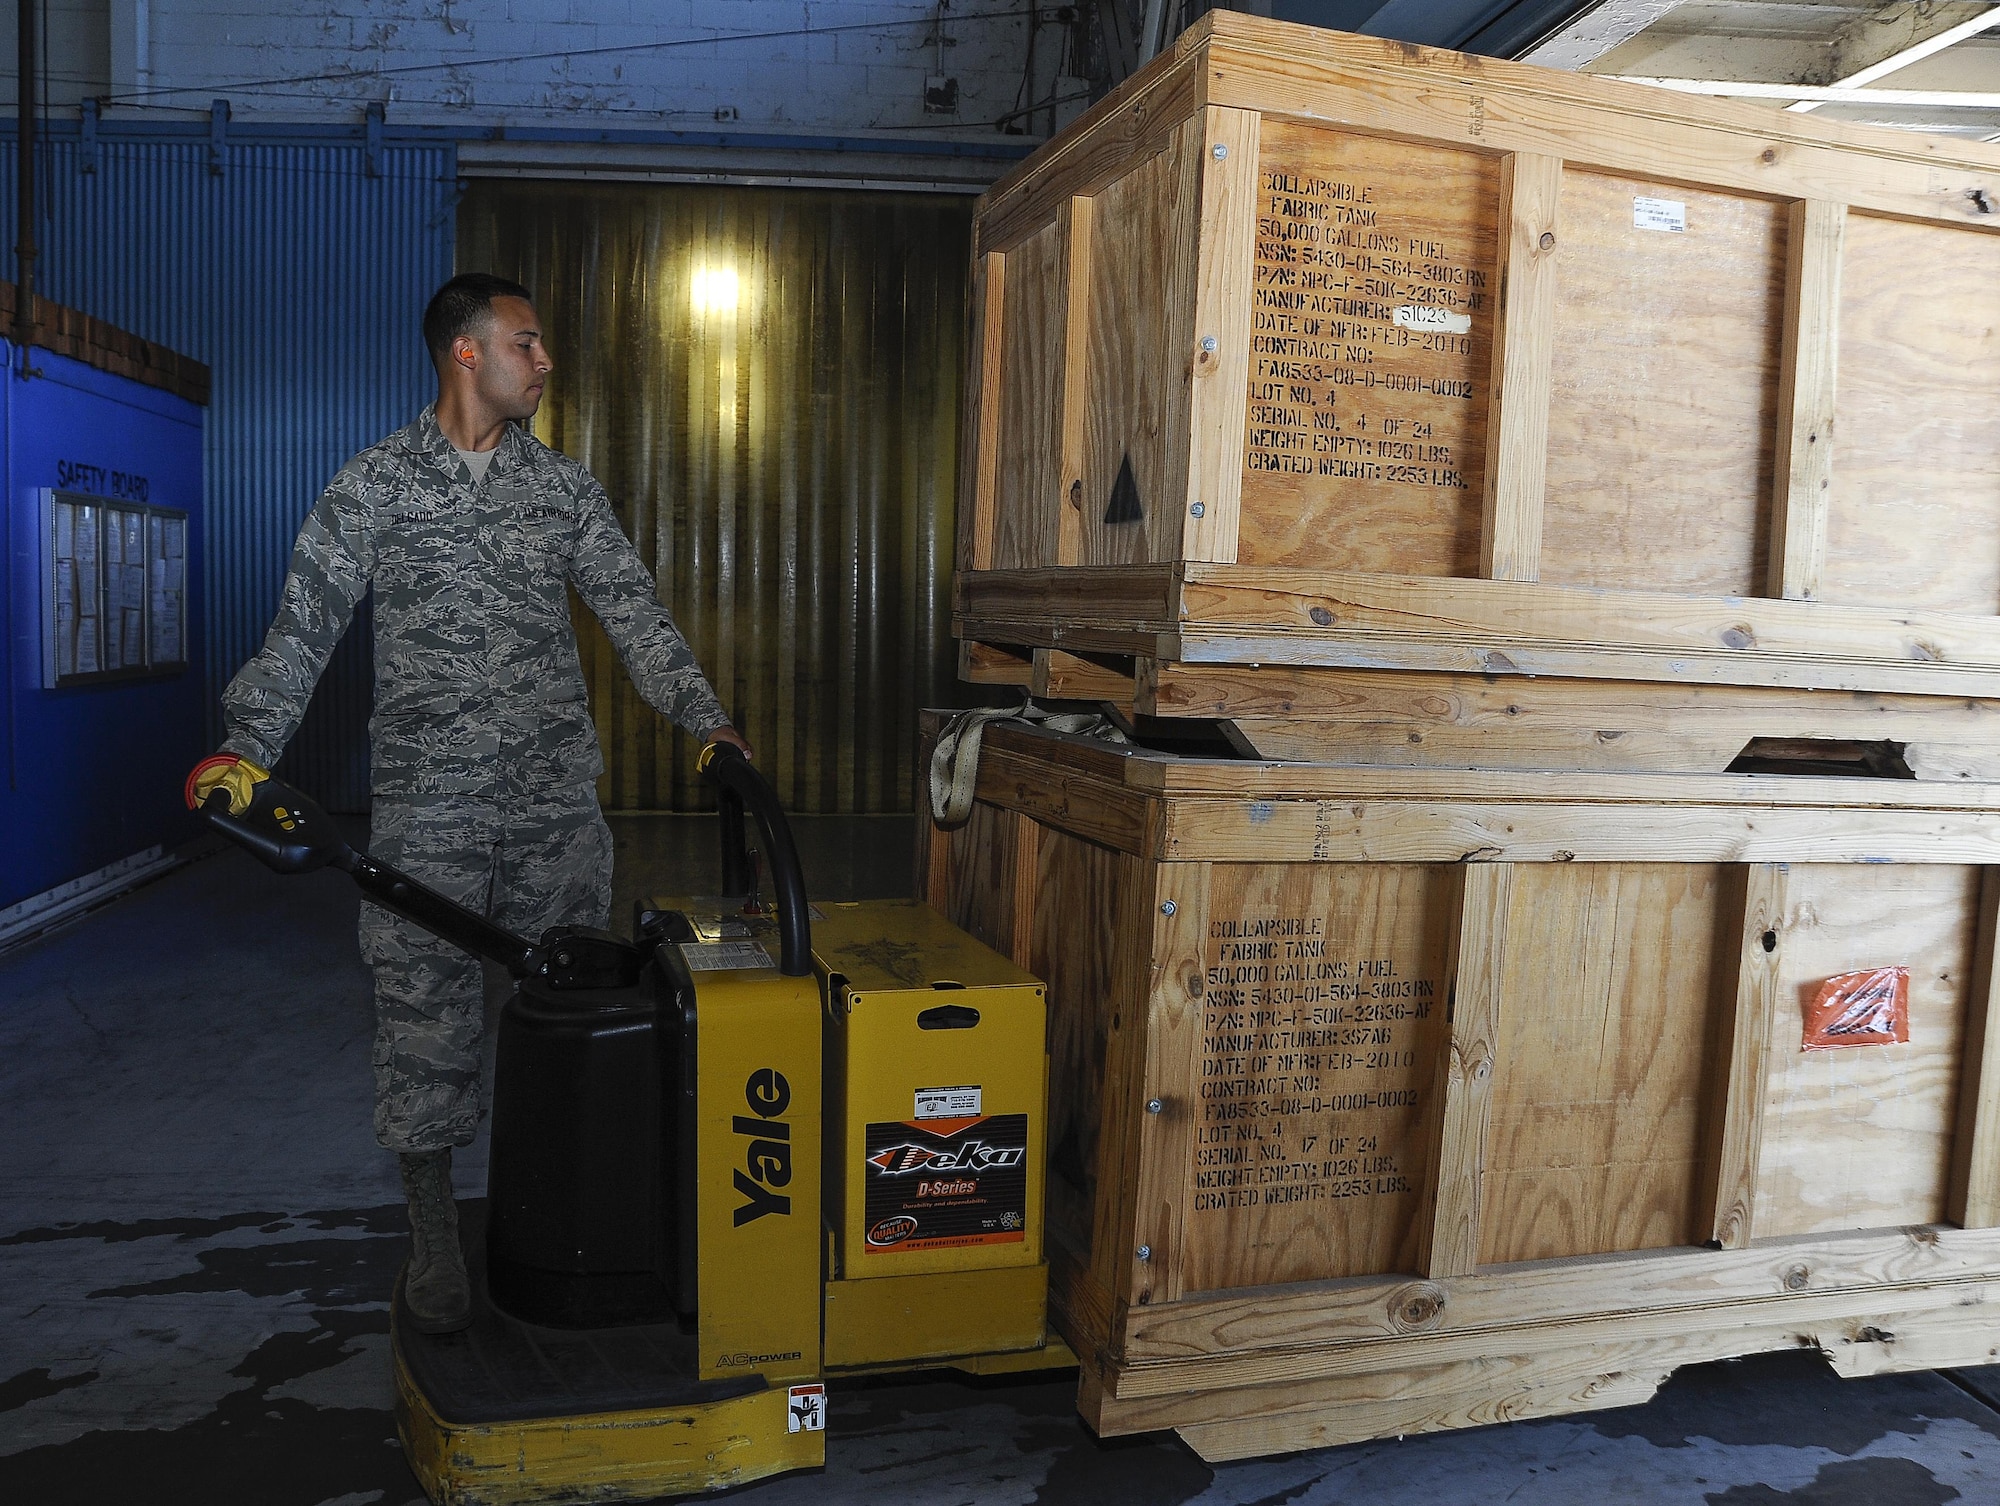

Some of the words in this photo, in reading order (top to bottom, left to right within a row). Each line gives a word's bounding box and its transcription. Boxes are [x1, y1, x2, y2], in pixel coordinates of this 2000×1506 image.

[1262, 173, 1373, 204] COLLAPSIBLE
[1271, 197, 1328, 221] FABRIC
[1335, 206, 1377, 228] TANK
[1260, 218, 1320, 242] 50,000
[1326, 229, 1399, 253] GALLONS
[1410, 239, 1450, 261] FUEL
[1258, 242, 1297, 264] NSN:
[1257, 265, 1296, 285] P/N:
[1256, 289, 1391, 321] MANUFACTURER:
[1401, 304, 1447, 324] 51C23
[1255, 311, 1298, 333] DATE
[1304, 317, 1325, 336] OF
[1254, 335, 1341, 361] CONTRACT
[1346, 344, 1373, 364] NO:
[1258, 358, 1473, 399] FA8533-08-D-0001-0002
[1251, 381, 1284, 402] LOT
[1290, 385, 1317, 407] NO.
[1325, 390, 1336, 406] 4
[1250, 405, 1308, 429] SERIAL
[1314, 411, 1341, 432] NO.
[1356, 414, 1367, 430] 4
[1384, 418, 1405, 436] OF
[1412, 422, 1432, 440] 24
[1250, 428, 1307, 450] WEIGHT
[1313, 433, 1372, 457] EMPTY:
[1377, 440, 1413, 460] 1026
[1418, 445, 1454, 466] LBS.
[58, 459, 106, 492] SAFETY
[112, 470, 149, 502] BOARD
[1248, 452, 1313, 475] CRATED
[1319, 458, 1381, 480] WEIGHT:
[1386, 464, 1427, 485] 2253
[1432, 469, 1469, 489] LBS.
[390, 510, 433, 525] DELGADO
[1211, 918, 1322, 938] COLLAPSIBLE
[1220, 942, 1278, 961] FABRIC
[1285, 939, 1326, 959] TANK
[1208, 966, 1269, 987] 50,000
[1275, 961, 1348, 983] GALLONS
[1358, 960, 1398, 978] FUEL
[1206, 990, 1245, 1008] NSN:
[1205, 1013, 1244, 1031] P/N:
[1204, 1029, 1337, 1054] MANUFACTURER:
[1203, 1058, 1245, 1077] DATE
[1252, 1055, 1273, 1073] OF
[1202, 1077, 1288, 1100] CONTRACT
[1293, 1075, 1320, 1093] NO:
[1206, 1090, 1417, 1121] FA8533-08-D-0001-0002
[1199, 1125, 1232, 1144] LOT
[1237, 1123, 1263, 1142] NO.
[1272, 1121, 1282, 1137] 4
[732, 1068, 791, 1228] Yale
[867, 1141, 1024, 1174] Deka
[1198, 1146, 1253, 1166] SERIAL
[1260, 1143, 1286, 1162] NO.
[1302, 1136, 1317, 1154] 17
[1329, 1137, 1349, 1155] OF
[1357, 1135, 1377, 1153] 24
[1197, 1167, 1253, 1189] WEIGHT
[1259, 1163, 1317, 1184] EMPTY:
[1323, 1159, 1357, 1177] 1026
[1363, 1156, 1398, 1174] LBS.
[916, 1178, 976, 1198] D-Series
[1195, 1189, 1258, 1211] CRATED
[1265, 1186, 1325, 1205] WEIGHT:
[1331, 1179, 1371, 1198] 2253
[1376, 1176, 1412, 1194] LBS.
[902, 1202, 932, 1210] Durability
[946, 1198, 989, 1207] dependability.
[874, 1221, 911, 1240] QUALITY
[880, 1219, 903, 1229] BECAUSE
[884, 1231, 907, 1240] MATTERS
